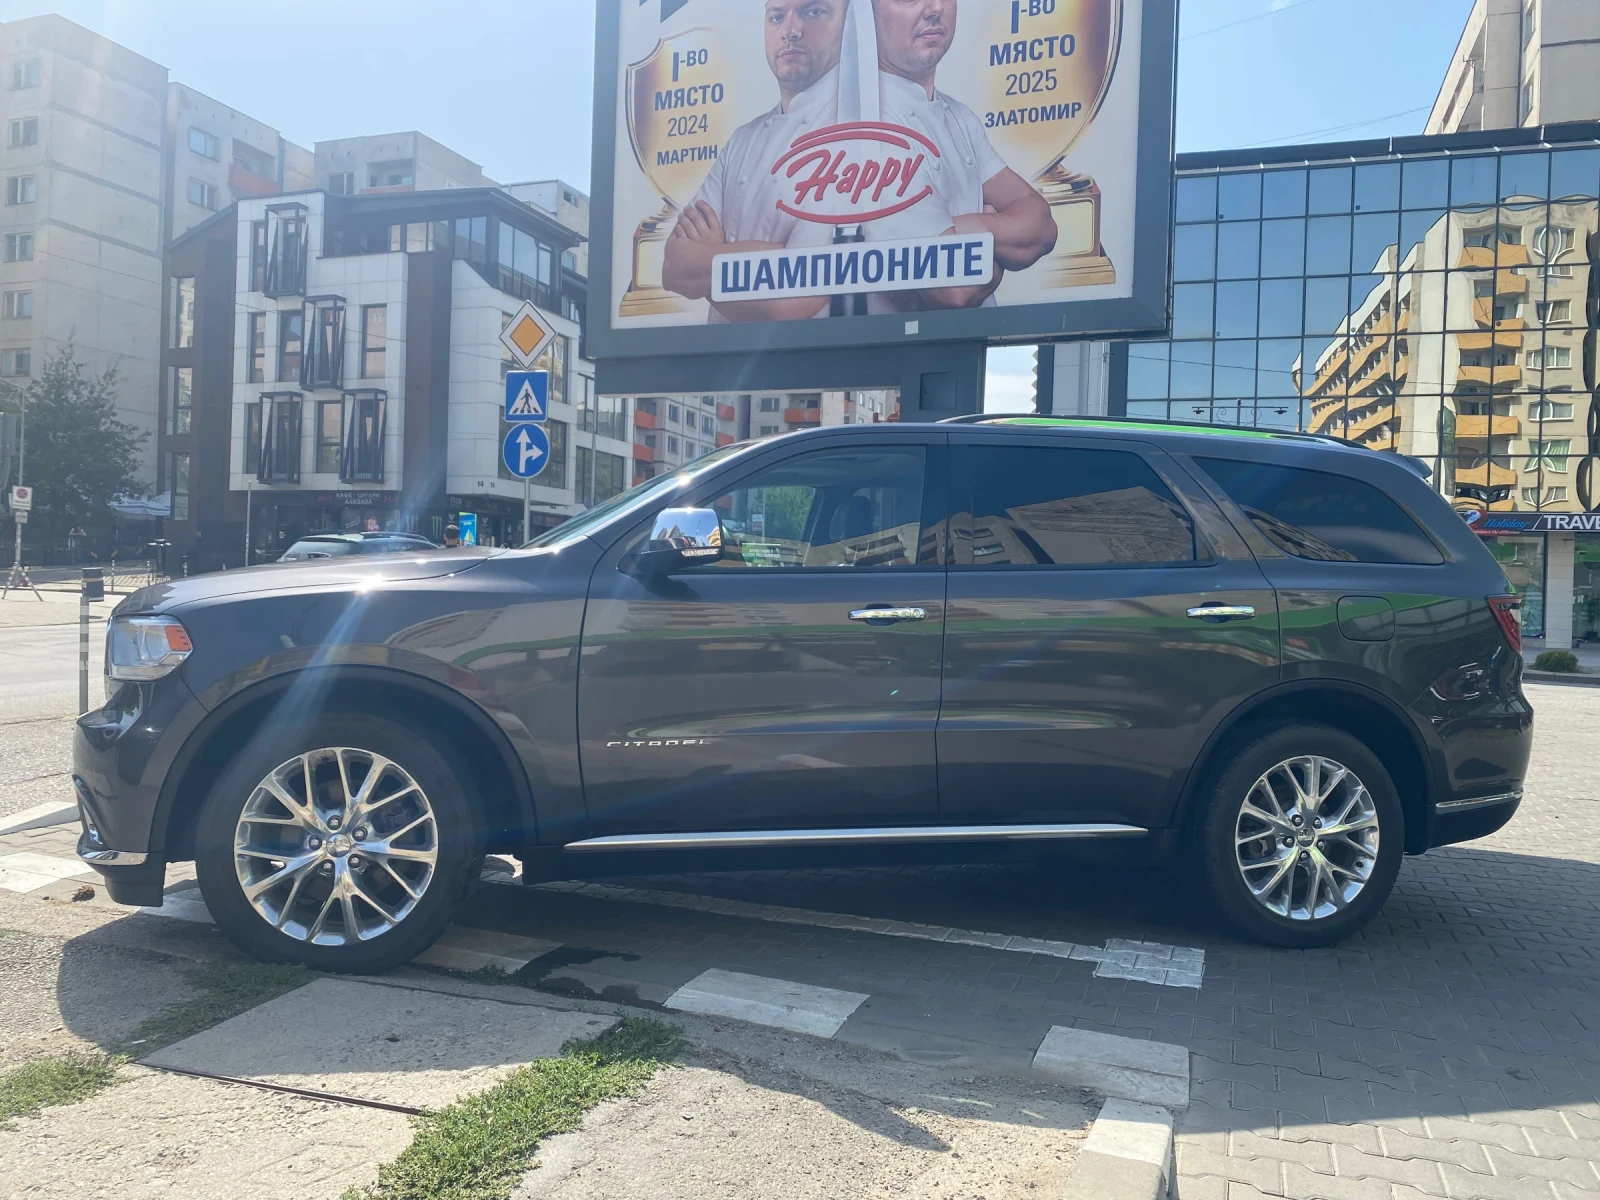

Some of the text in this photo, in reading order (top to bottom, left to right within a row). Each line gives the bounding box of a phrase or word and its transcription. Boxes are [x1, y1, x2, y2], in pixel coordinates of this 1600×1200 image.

[990, 34, 1076, 66] МЯСТО
[1005, 68, 1058, 96] 2025
[654, 82, 724, 111] МЯСТО
[667, 113, 708, 137] 2024
[984, 101, 1082, 128] ЗЛАТОМИР
[656, 144, 718, 166] МАРТИН
[786, 149, 924, 205] Happy
[721, 241, 983, 293] ШАМПИОНИТЕ
[1484, 518, 1528, 530] Holiday
[606, 739, 711, 747] CITADEL
